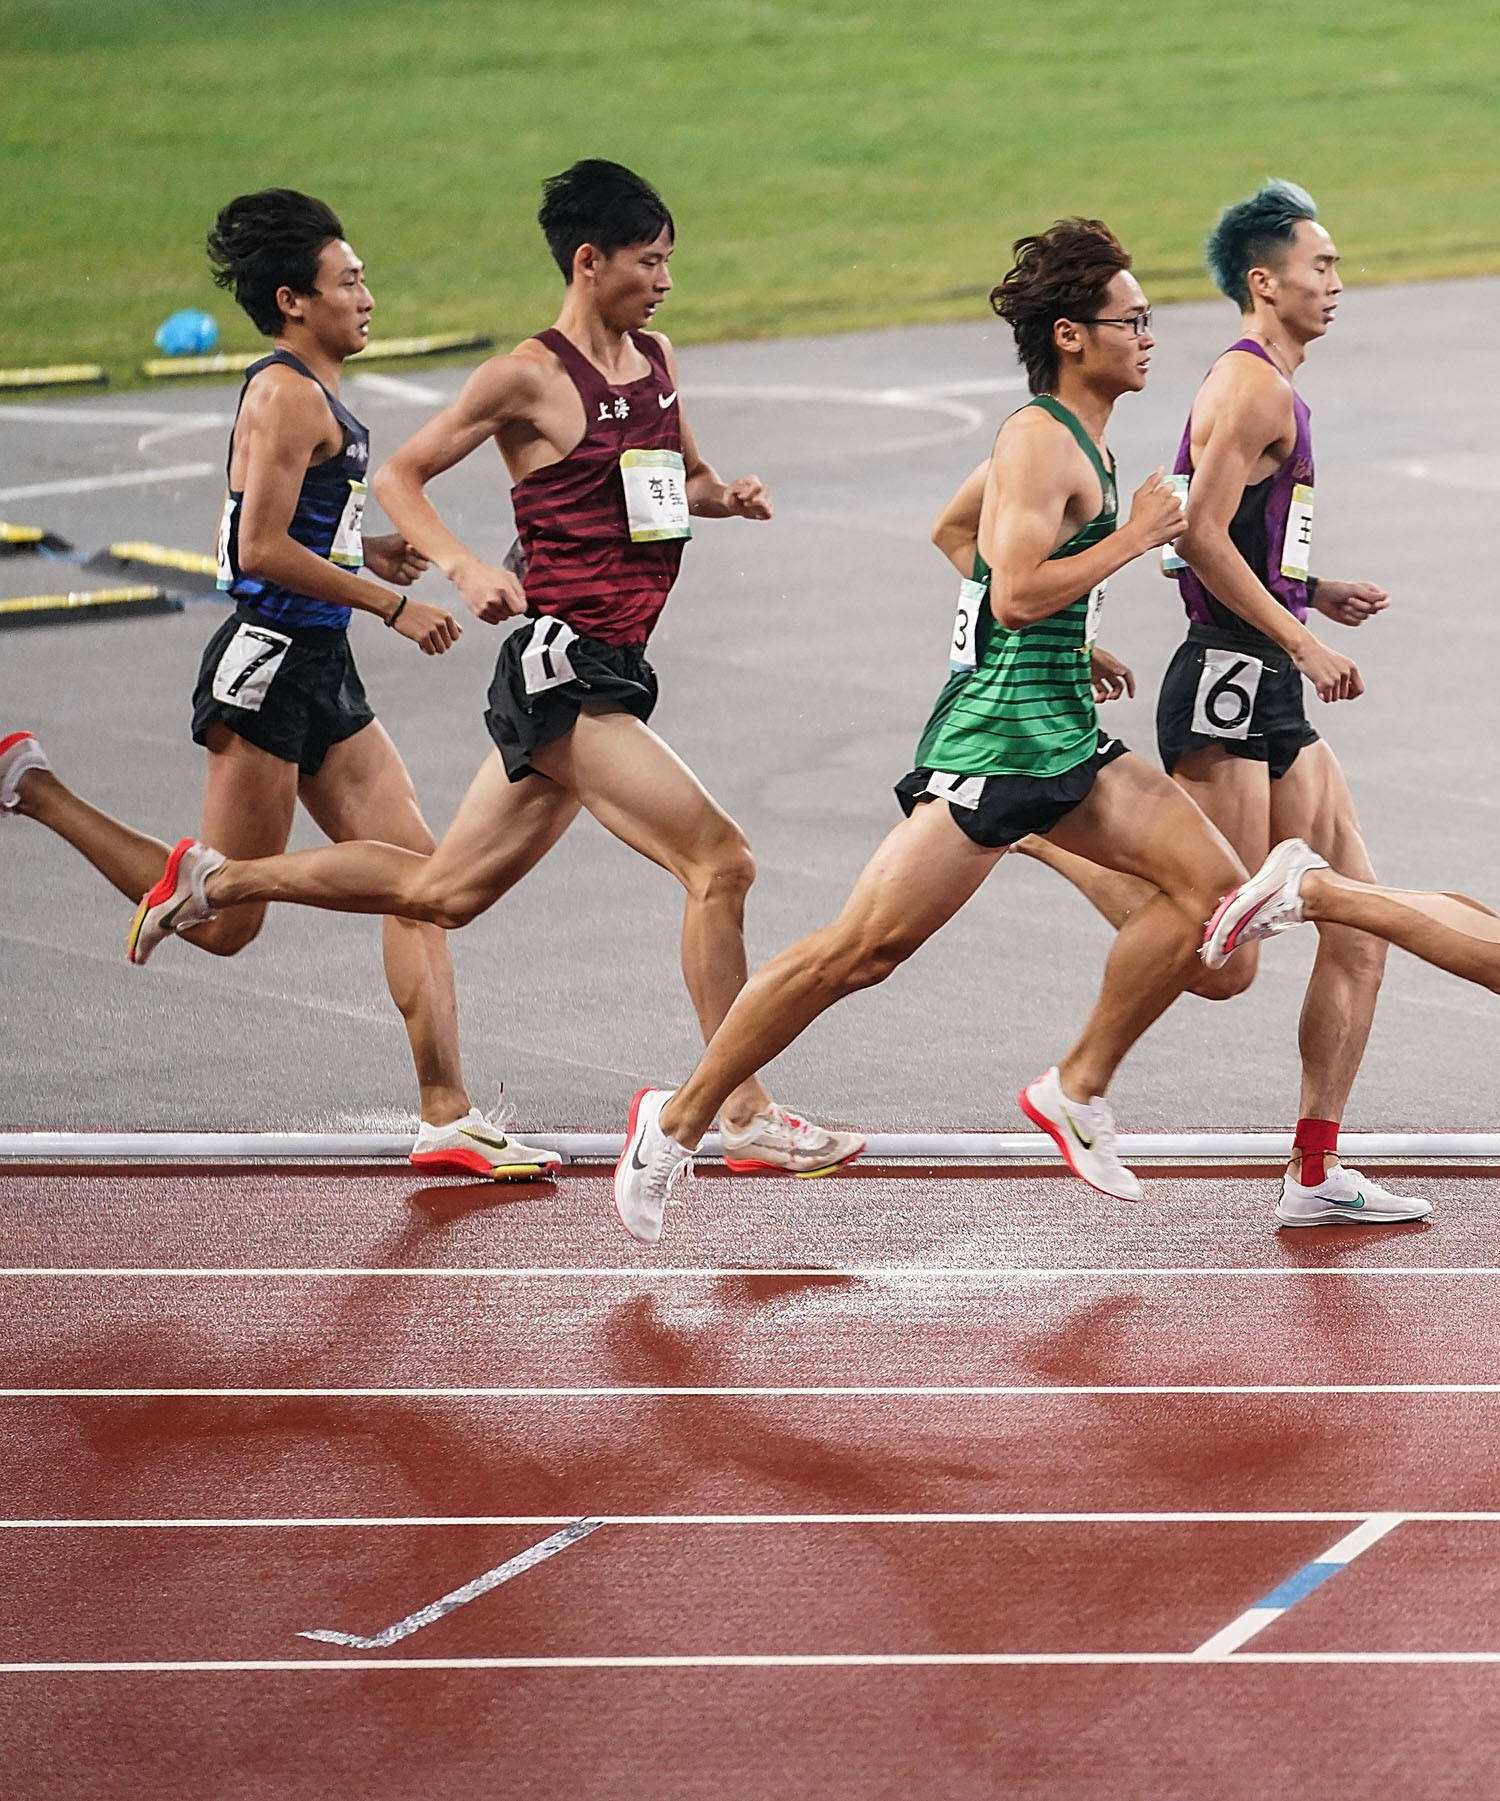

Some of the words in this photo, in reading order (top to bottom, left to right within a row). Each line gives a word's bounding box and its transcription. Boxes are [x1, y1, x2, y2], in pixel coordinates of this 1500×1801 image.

[597, 397, 630, 421] 上海
[227, 630, 288, 697] 7
[1205, 660, 1250, 730] 6
